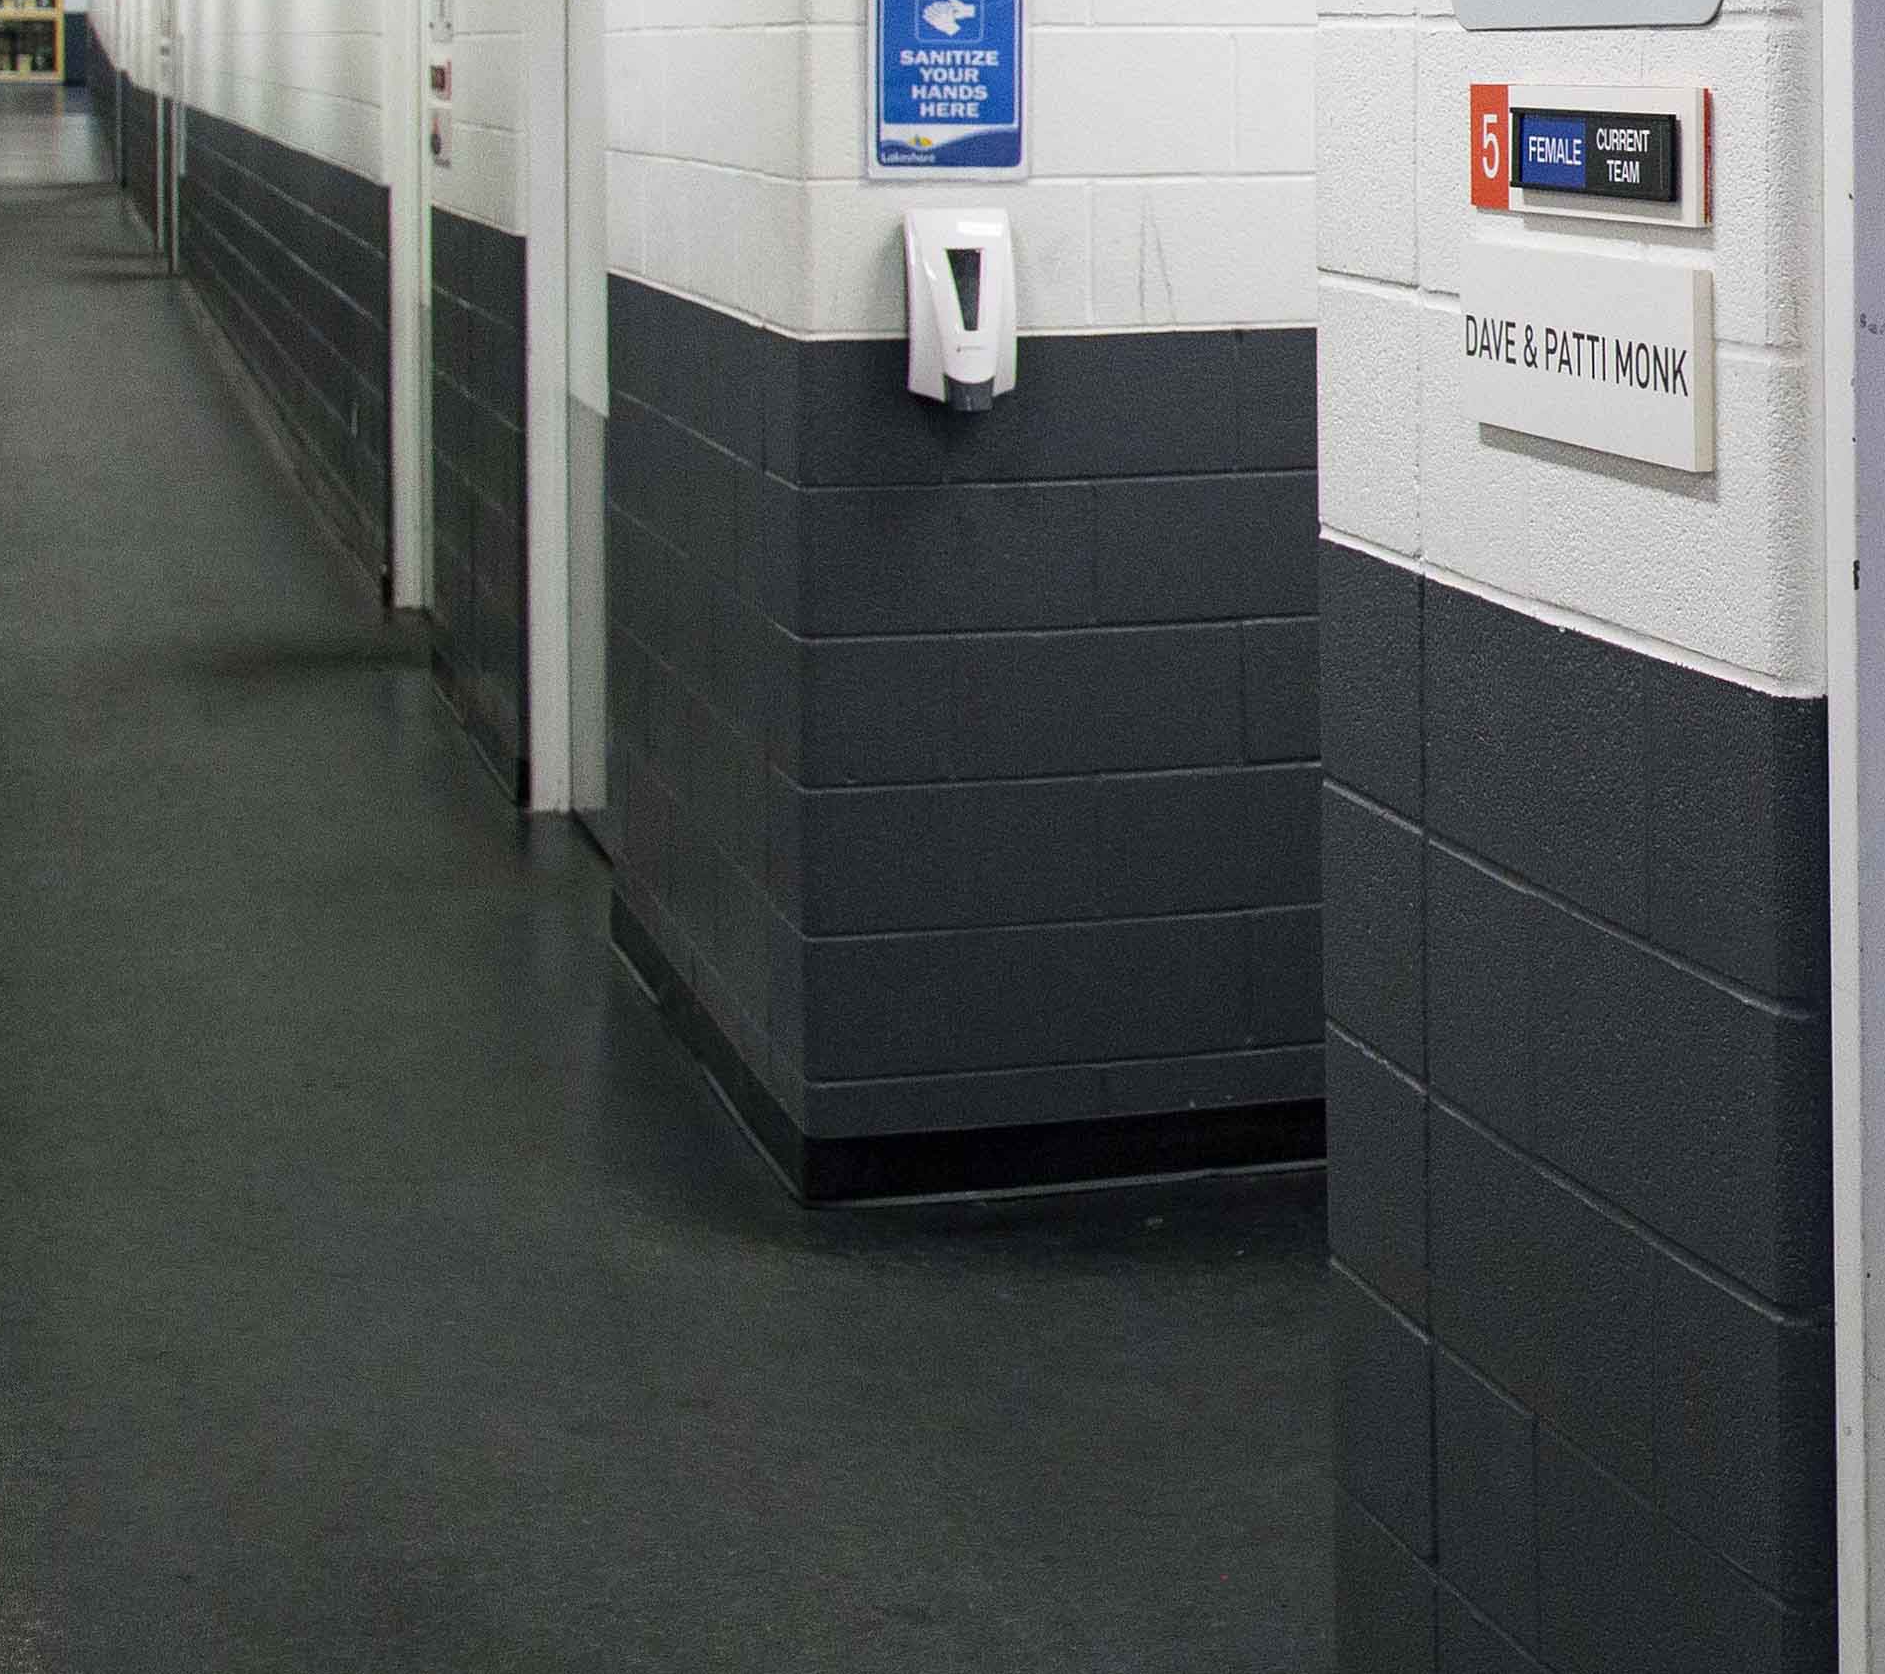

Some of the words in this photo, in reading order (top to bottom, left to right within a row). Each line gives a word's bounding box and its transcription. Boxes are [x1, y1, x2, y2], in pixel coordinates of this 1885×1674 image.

[899, 49, 1000, 67] SANITIZE
[919, 67, 980, 83] YOUR
[910, 84, 989, 101] HANDS
[919, 101, 981, 118] HERE
[1482, 113, 1500, 179] 5
[1528, 136, 1582, 166] FEMALE
[1596, 127, 1650, 154] CURRENT
[1606, 159, 1641, 184] TEAM
[1465, 314, 1517, 365] DAVE
[1523, 324, 1539, 369] &
[1545, 327, 1607, 382] PATTI
[1615, 339, 1689, 397] MONK
